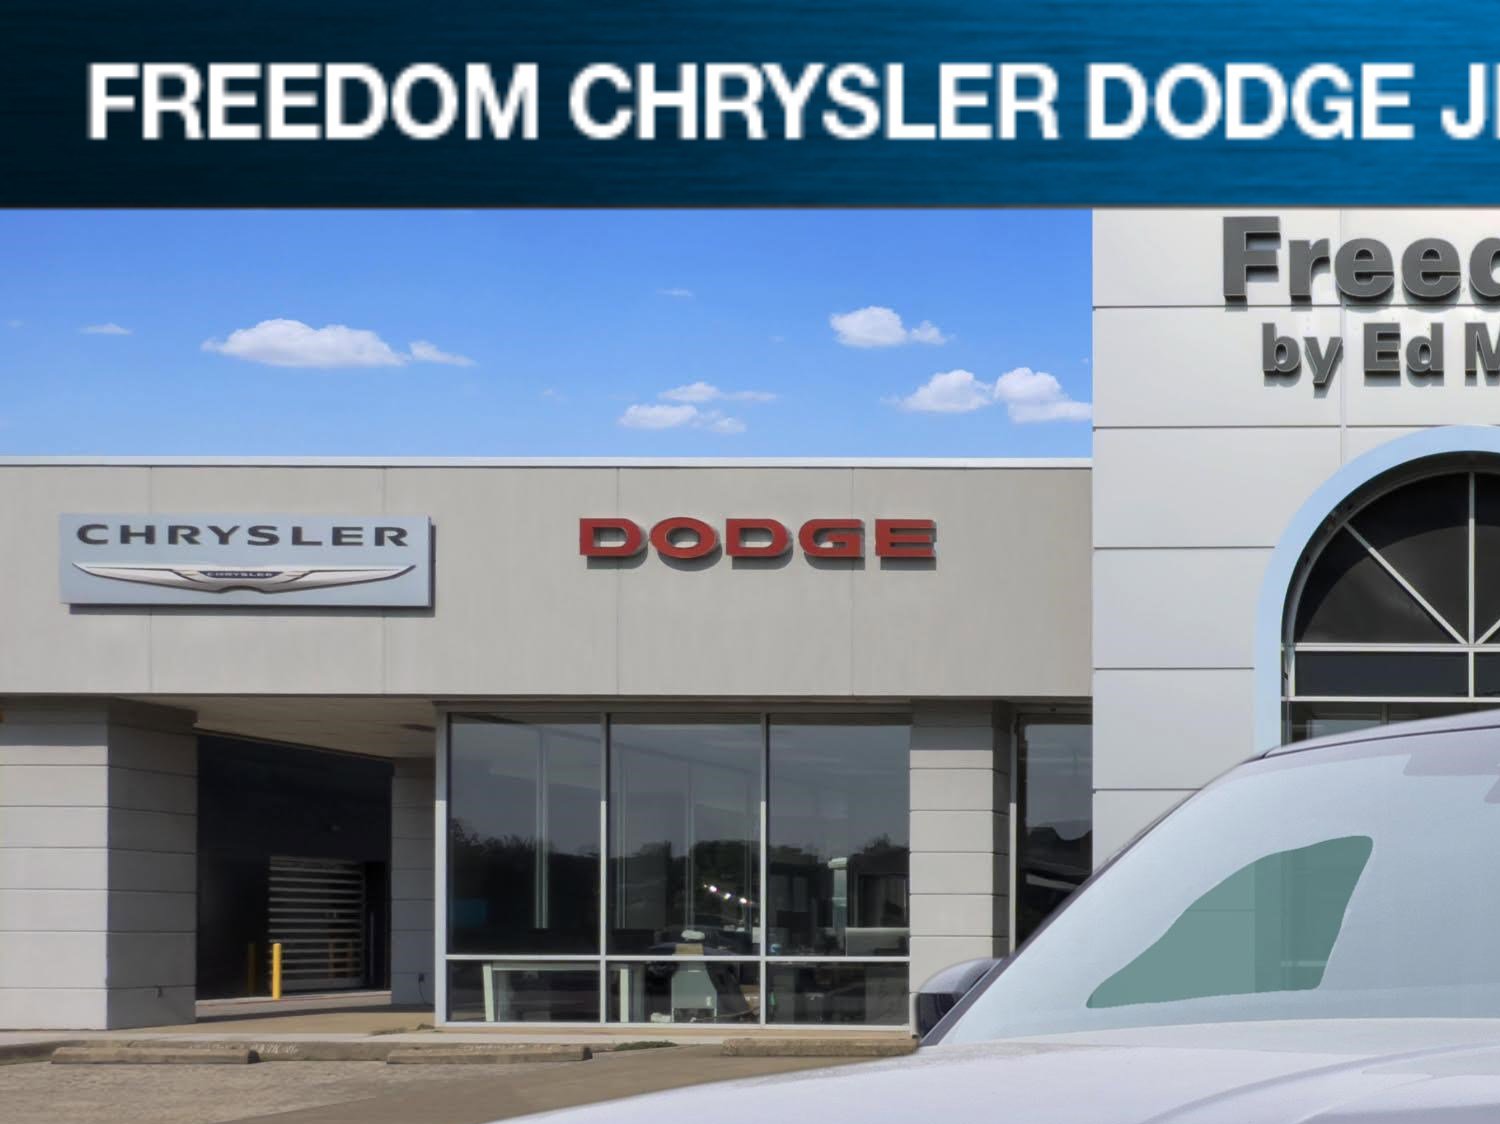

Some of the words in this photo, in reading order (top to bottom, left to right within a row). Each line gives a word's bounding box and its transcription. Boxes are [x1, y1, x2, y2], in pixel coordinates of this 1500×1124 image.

[1262, 322, 1343, 390] by
[1363, 322, 1445, 378] Ed
[76, 523, 409, 548] CHRYSLER
[579, 516, 936, 559] DODGE
